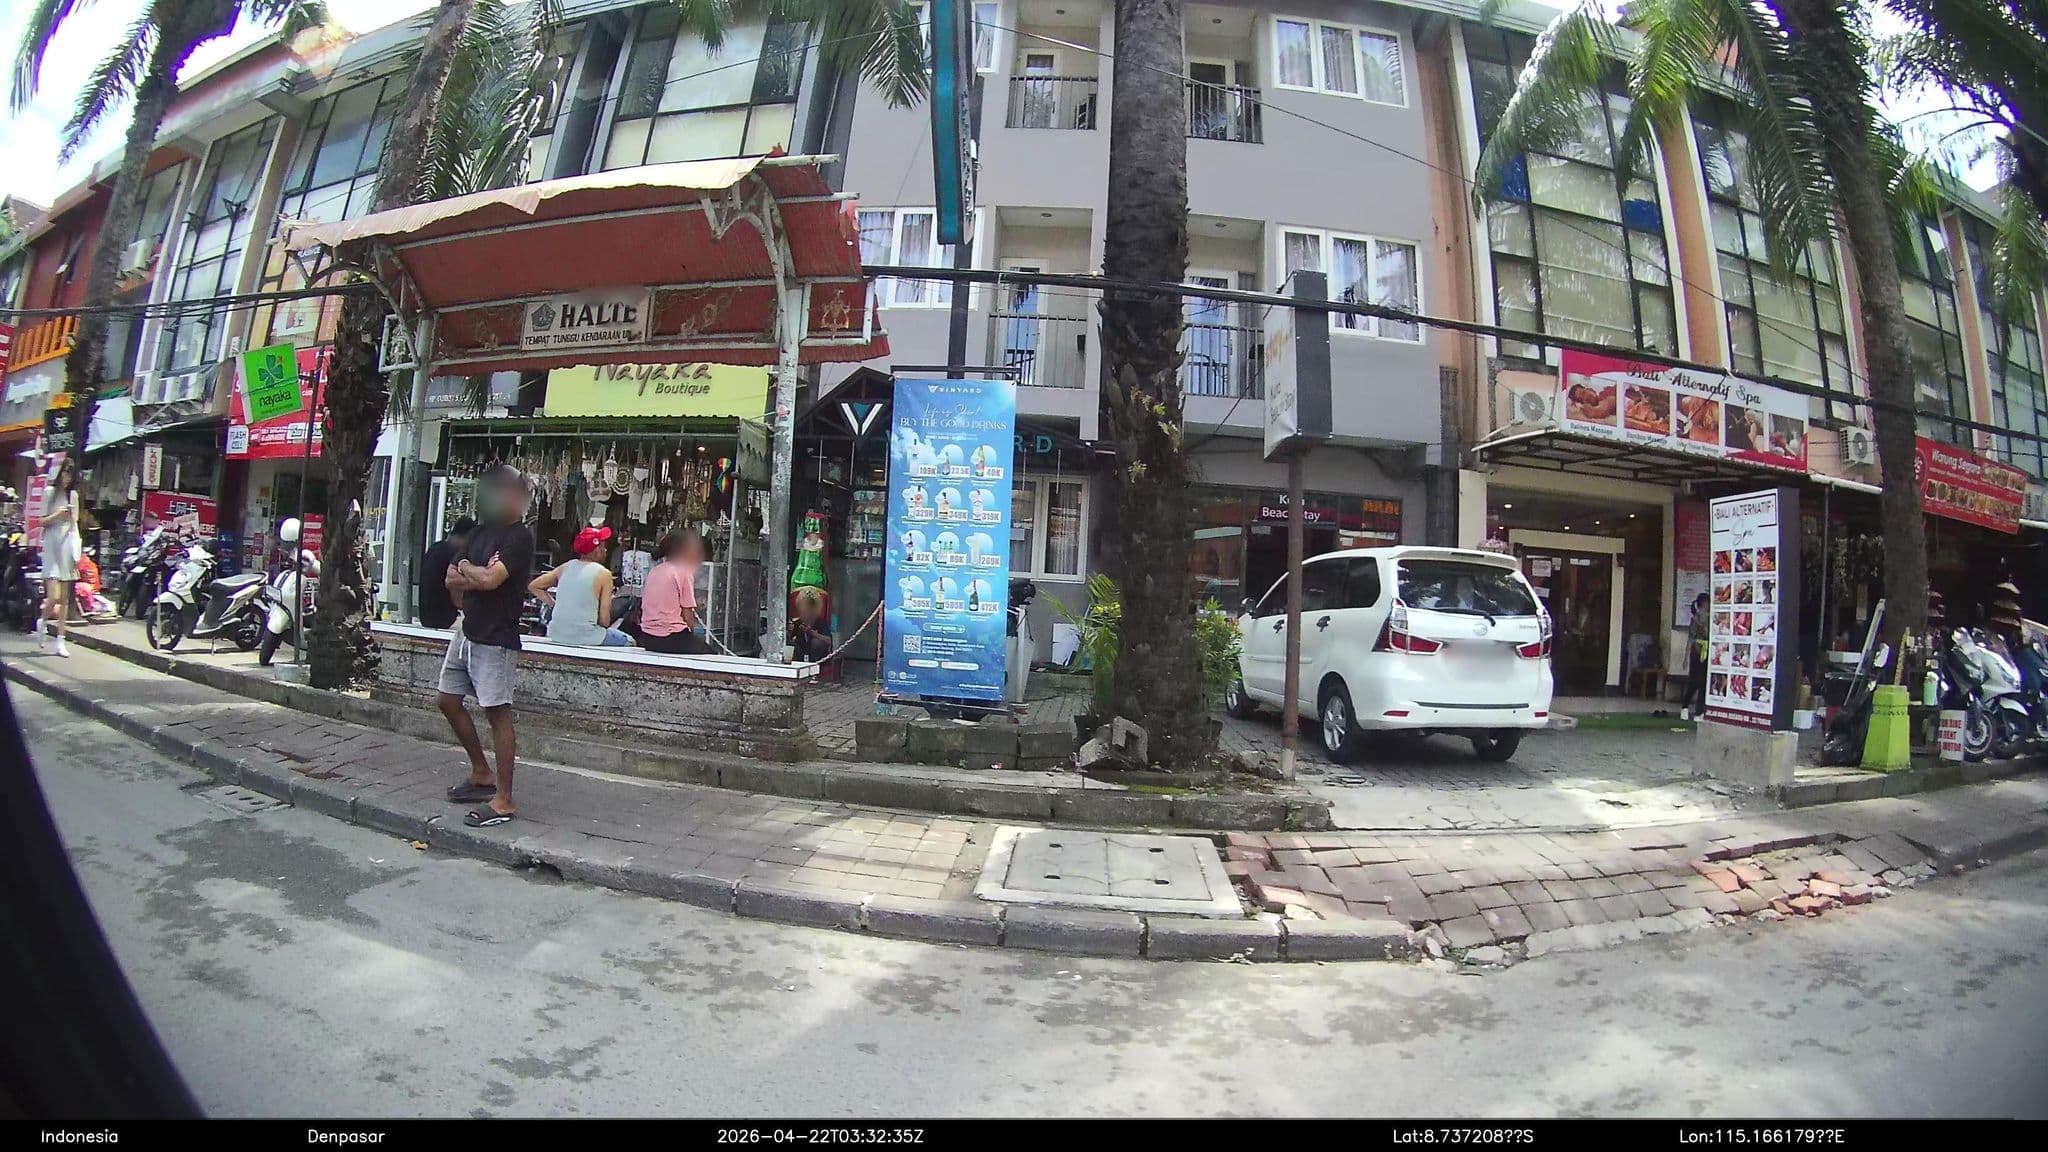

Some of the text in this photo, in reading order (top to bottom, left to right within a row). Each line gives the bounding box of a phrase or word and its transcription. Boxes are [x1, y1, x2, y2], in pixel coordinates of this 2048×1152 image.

[525, 335, 550, 345] TEMPAT
[553, 333, 579, 343] TUNGGU
[581, 329, 620, 341] KENDARAAN
[655, 382, 711, 396] Boutique
[1736, 385, 1762, 405] Spa
[259, 390, 292, 407] nayaka
[1932, 448, 1959, 471] Warung
[1262, 507, 1320, 522] Beac tay
